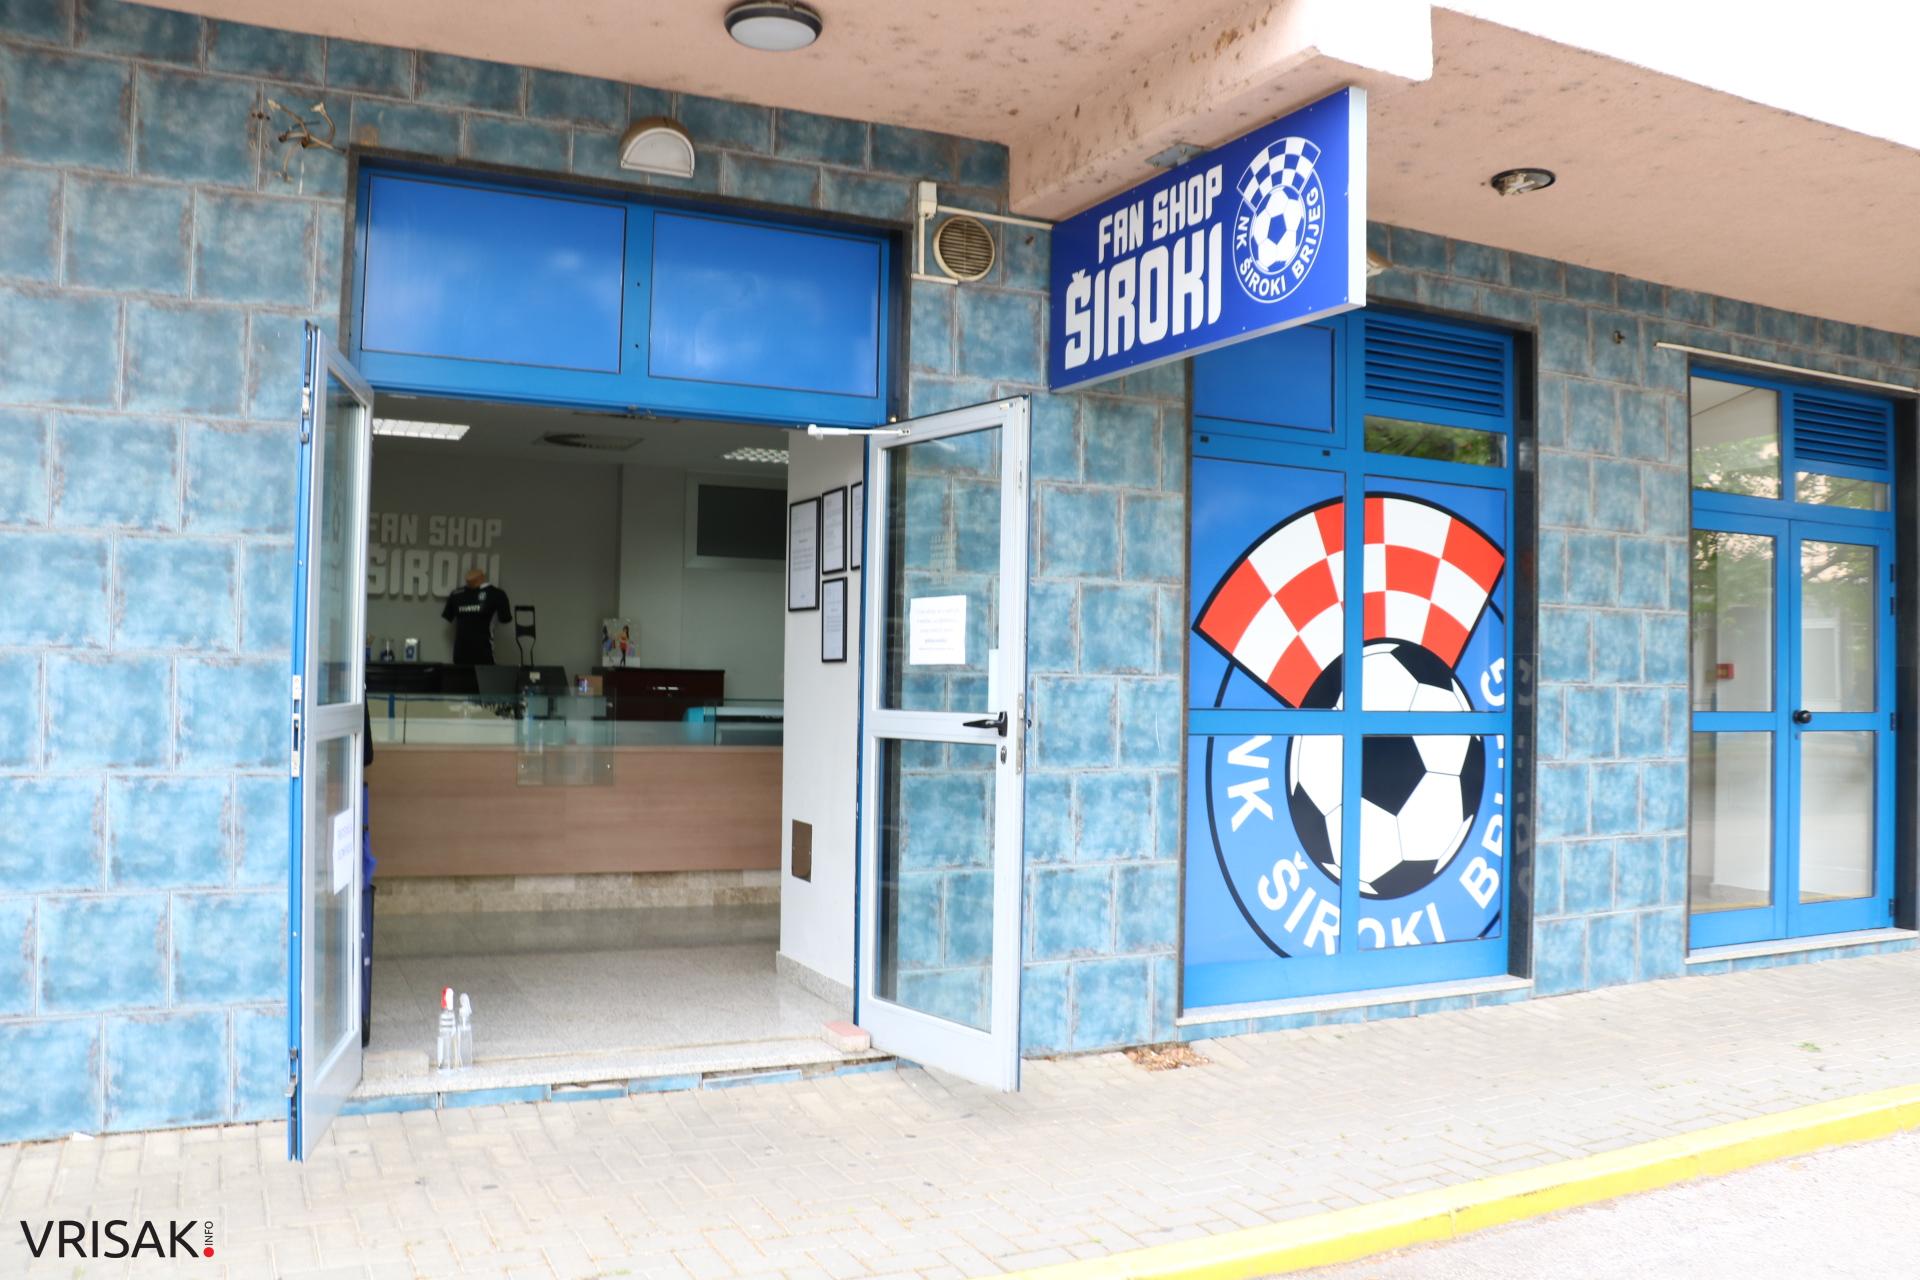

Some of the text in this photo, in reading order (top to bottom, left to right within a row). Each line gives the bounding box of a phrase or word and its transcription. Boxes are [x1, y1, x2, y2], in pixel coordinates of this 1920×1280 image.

[1098, 163, 1223, 264] FAN SHOP
[1236, 186, 1321, 297] NK ŠIROKI BRIJEG
[1064, 222, 1223, 371] ŠIROKI
[429, 515, 503, 549] SHOP
